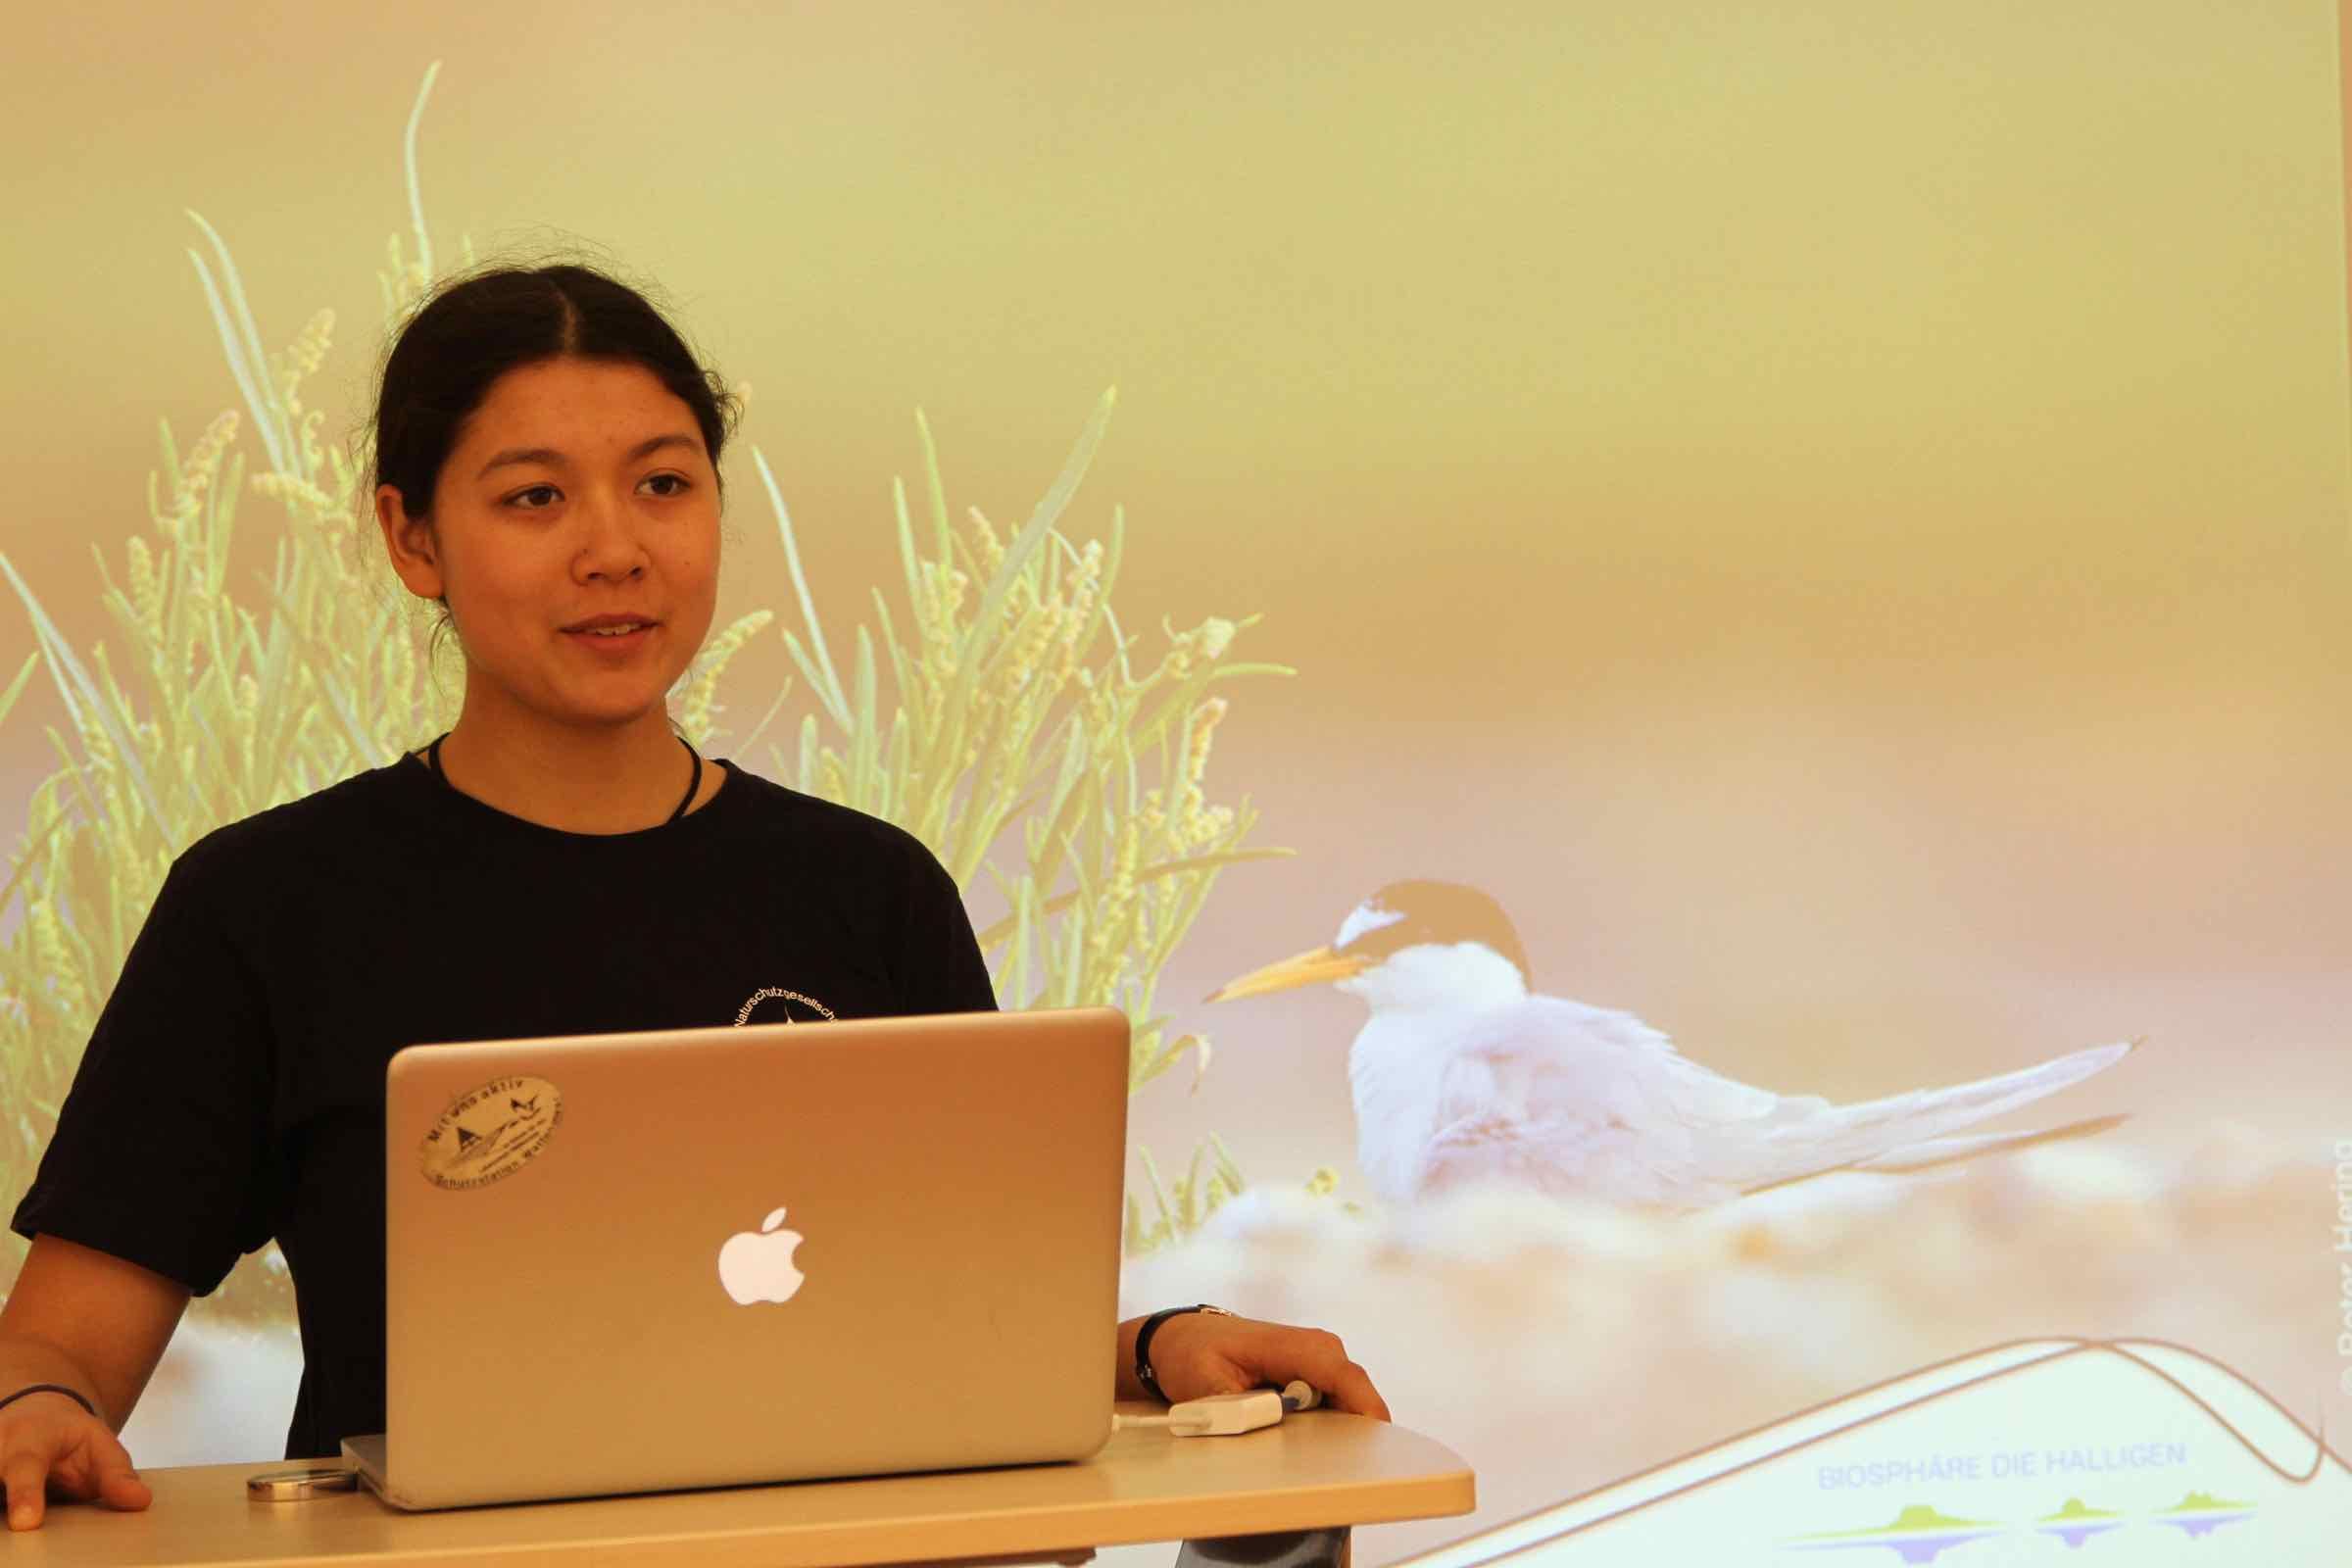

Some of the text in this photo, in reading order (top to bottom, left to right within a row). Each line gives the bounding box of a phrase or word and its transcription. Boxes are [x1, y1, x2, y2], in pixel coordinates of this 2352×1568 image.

[1819, 1442, 2187, 1490] BIOSPHÄRE DIE HALLIGEN
